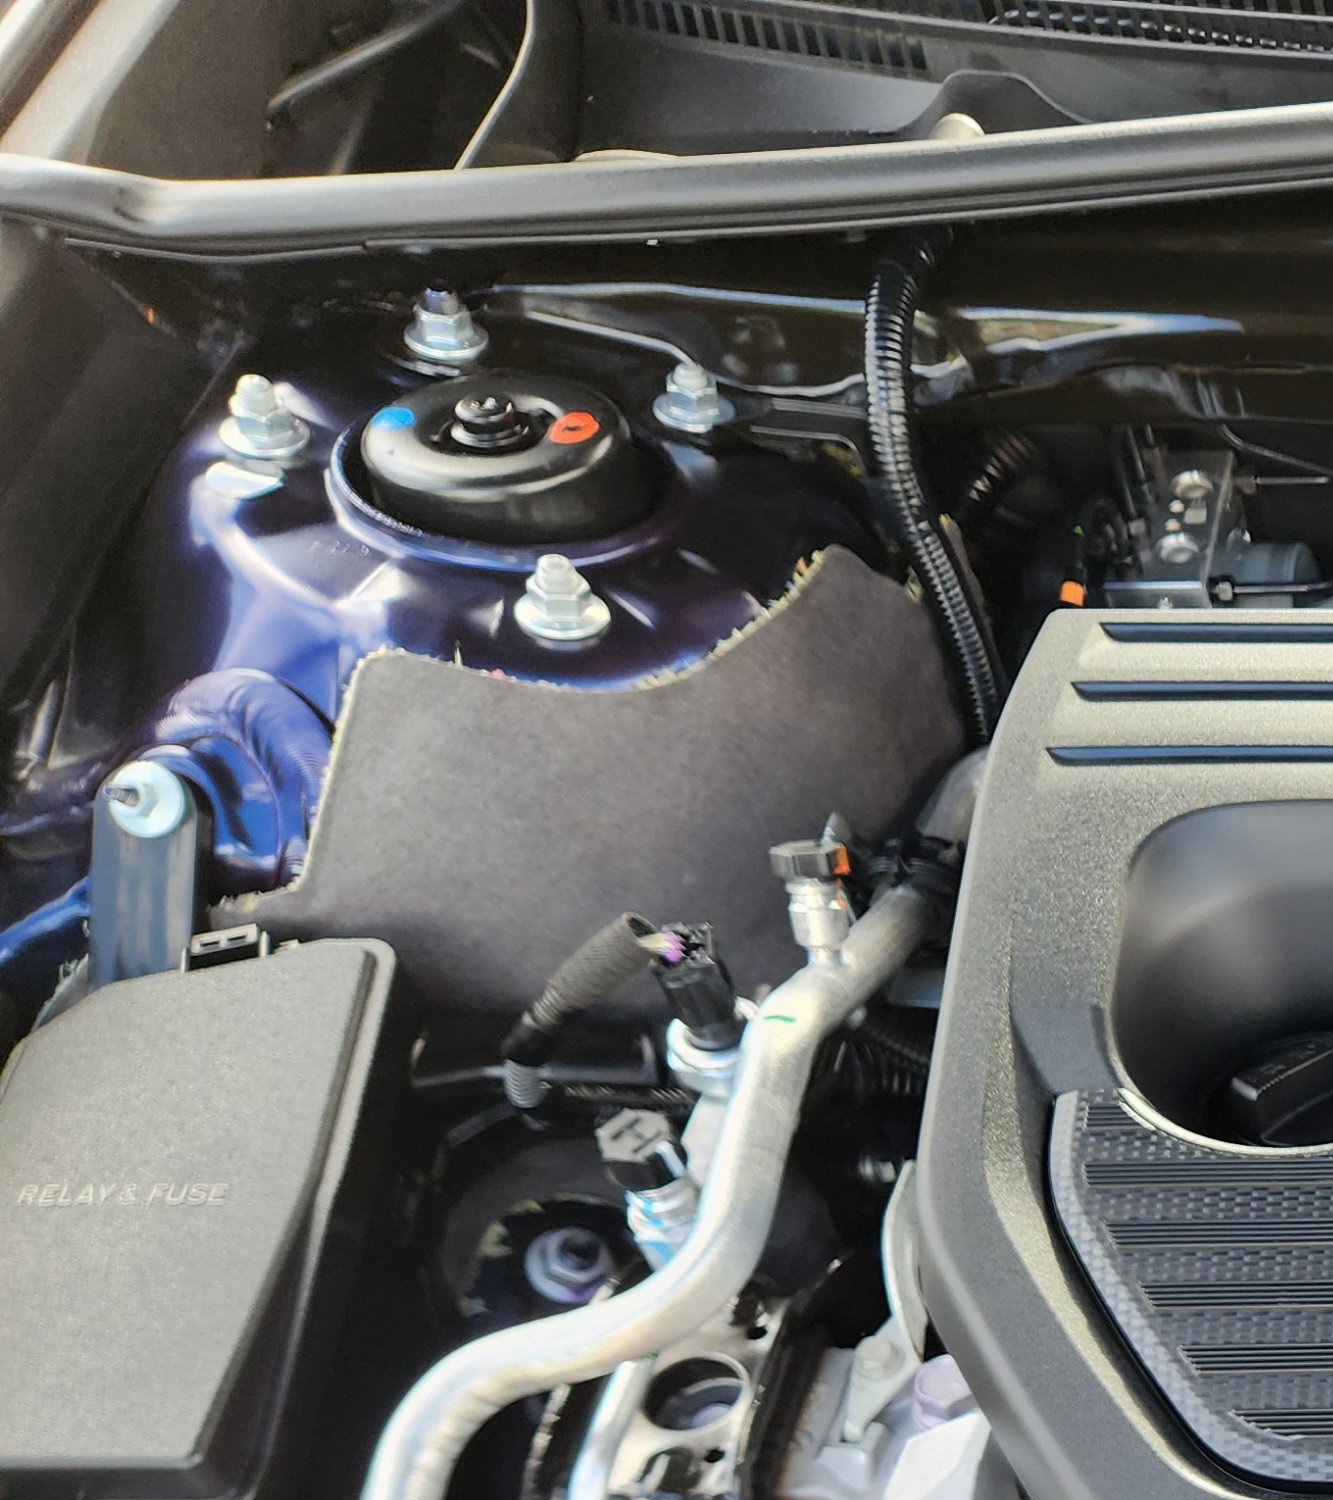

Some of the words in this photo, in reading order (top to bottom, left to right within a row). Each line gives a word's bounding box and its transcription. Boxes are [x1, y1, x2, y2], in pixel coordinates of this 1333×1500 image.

[17, 1183, 117, 1206] RELAY
[119, 1183, 137, 1206] &
[148, 1183, 229, 1206] FUSE
